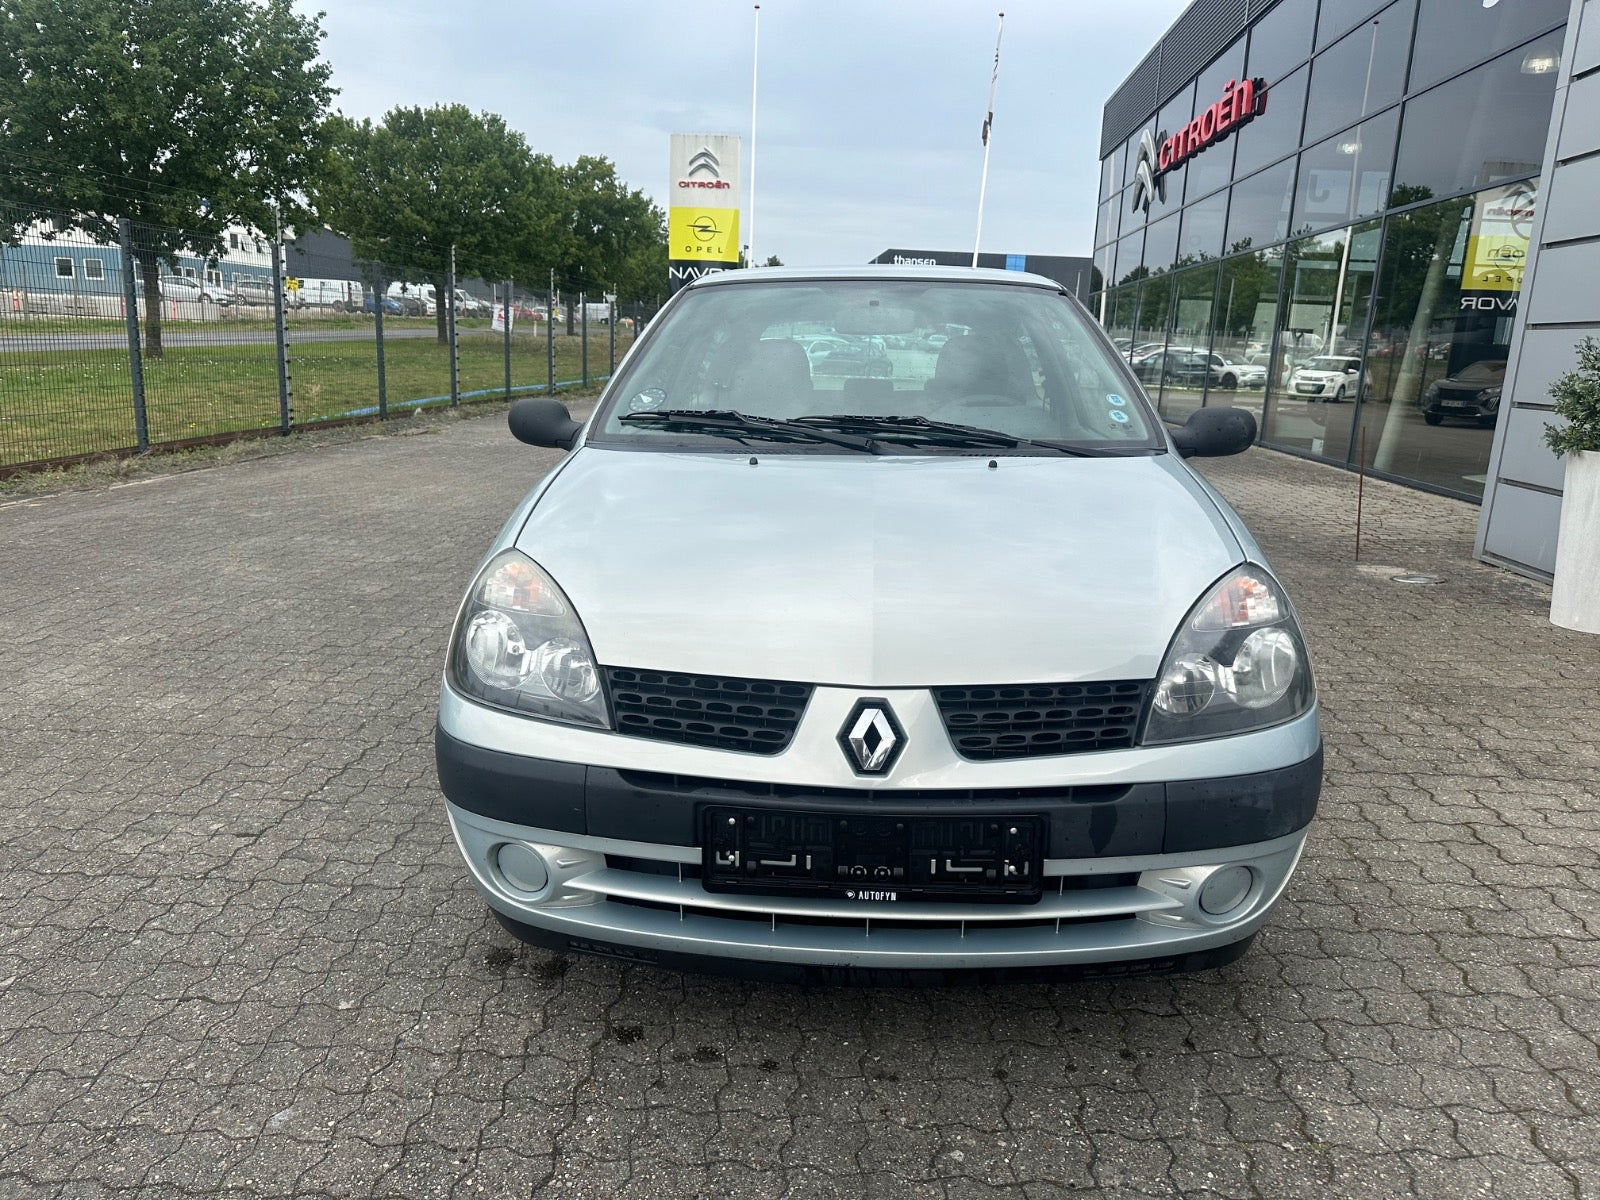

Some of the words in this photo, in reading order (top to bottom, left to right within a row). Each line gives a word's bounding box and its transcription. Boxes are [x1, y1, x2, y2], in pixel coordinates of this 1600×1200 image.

[1159, 78, 1254, 170] CITROËN
[678, 180, 731, 189] CITROËN
[685, 245, 723, 254] OPEL
[894, 254, 936, 265] thansen
[669, 266, 732, 279] NAV
[858, 890, 897, 901] AUTOFYN
